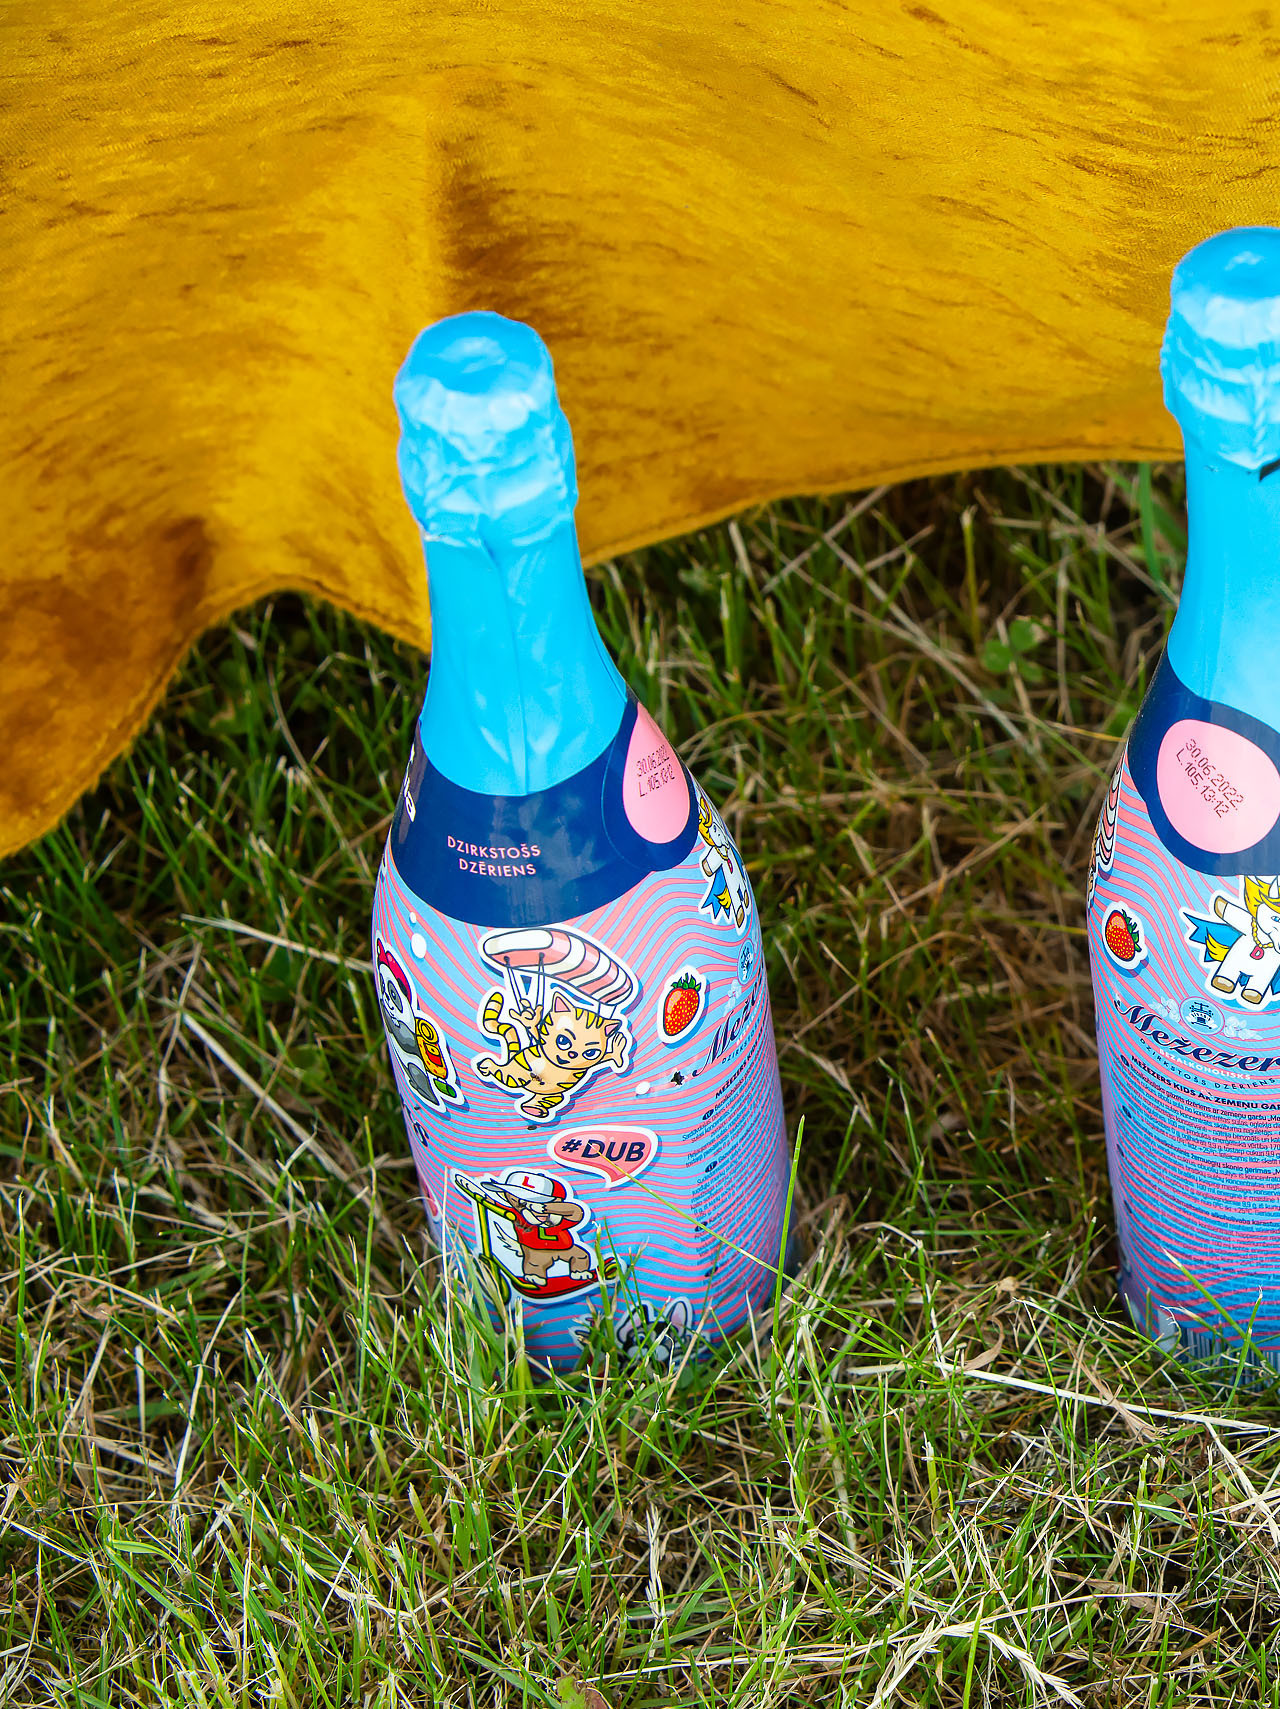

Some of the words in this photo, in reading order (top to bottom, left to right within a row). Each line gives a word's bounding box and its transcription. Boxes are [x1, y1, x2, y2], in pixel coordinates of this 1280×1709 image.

[447, 835, 541, 859] DZIRKSTOŠS
[459, 858, 536, 877] DZĒRIENS
[1159, 1048, 1251, 1081] BEZALKOHOLISKS
[1173, 1083, 1197, 1096] KIDS
[1214, 1096, 1258, 1109] ZEMEŅU
[561, 1138, 646, 1162] #DUB
[522, 1175, 535, 1189] L
[538, 1227, 558, 1241] L
